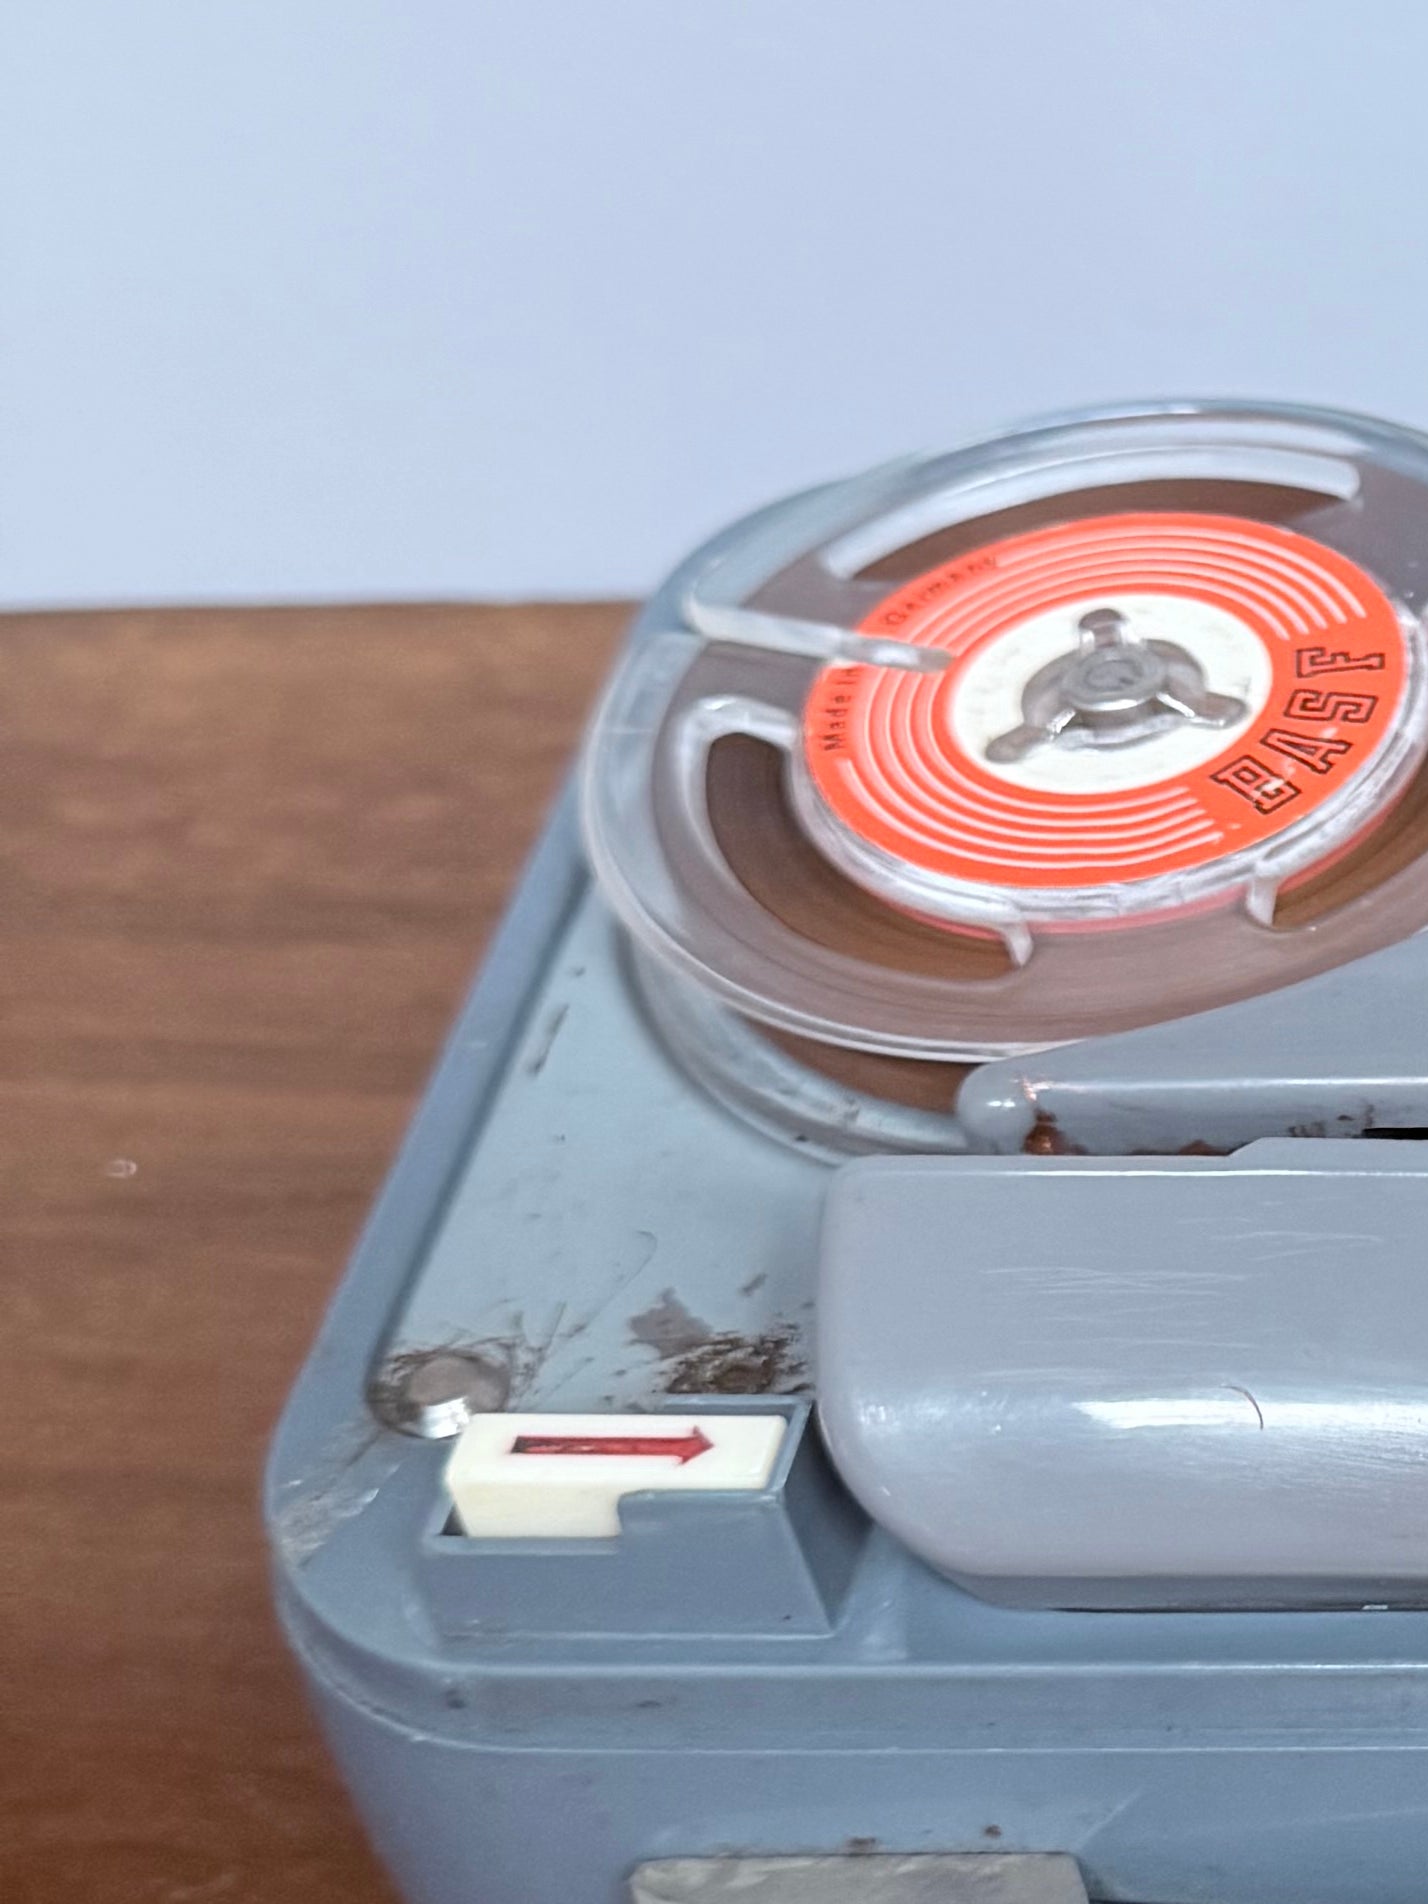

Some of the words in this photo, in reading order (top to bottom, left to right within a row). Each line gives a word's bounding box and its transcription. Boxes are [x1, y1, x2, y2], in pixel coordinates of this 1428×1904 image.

[822, 695, 850, 751] Made
[885, 556, 998, 626] Germany
[1209, 647, 1386, 816] BASF
